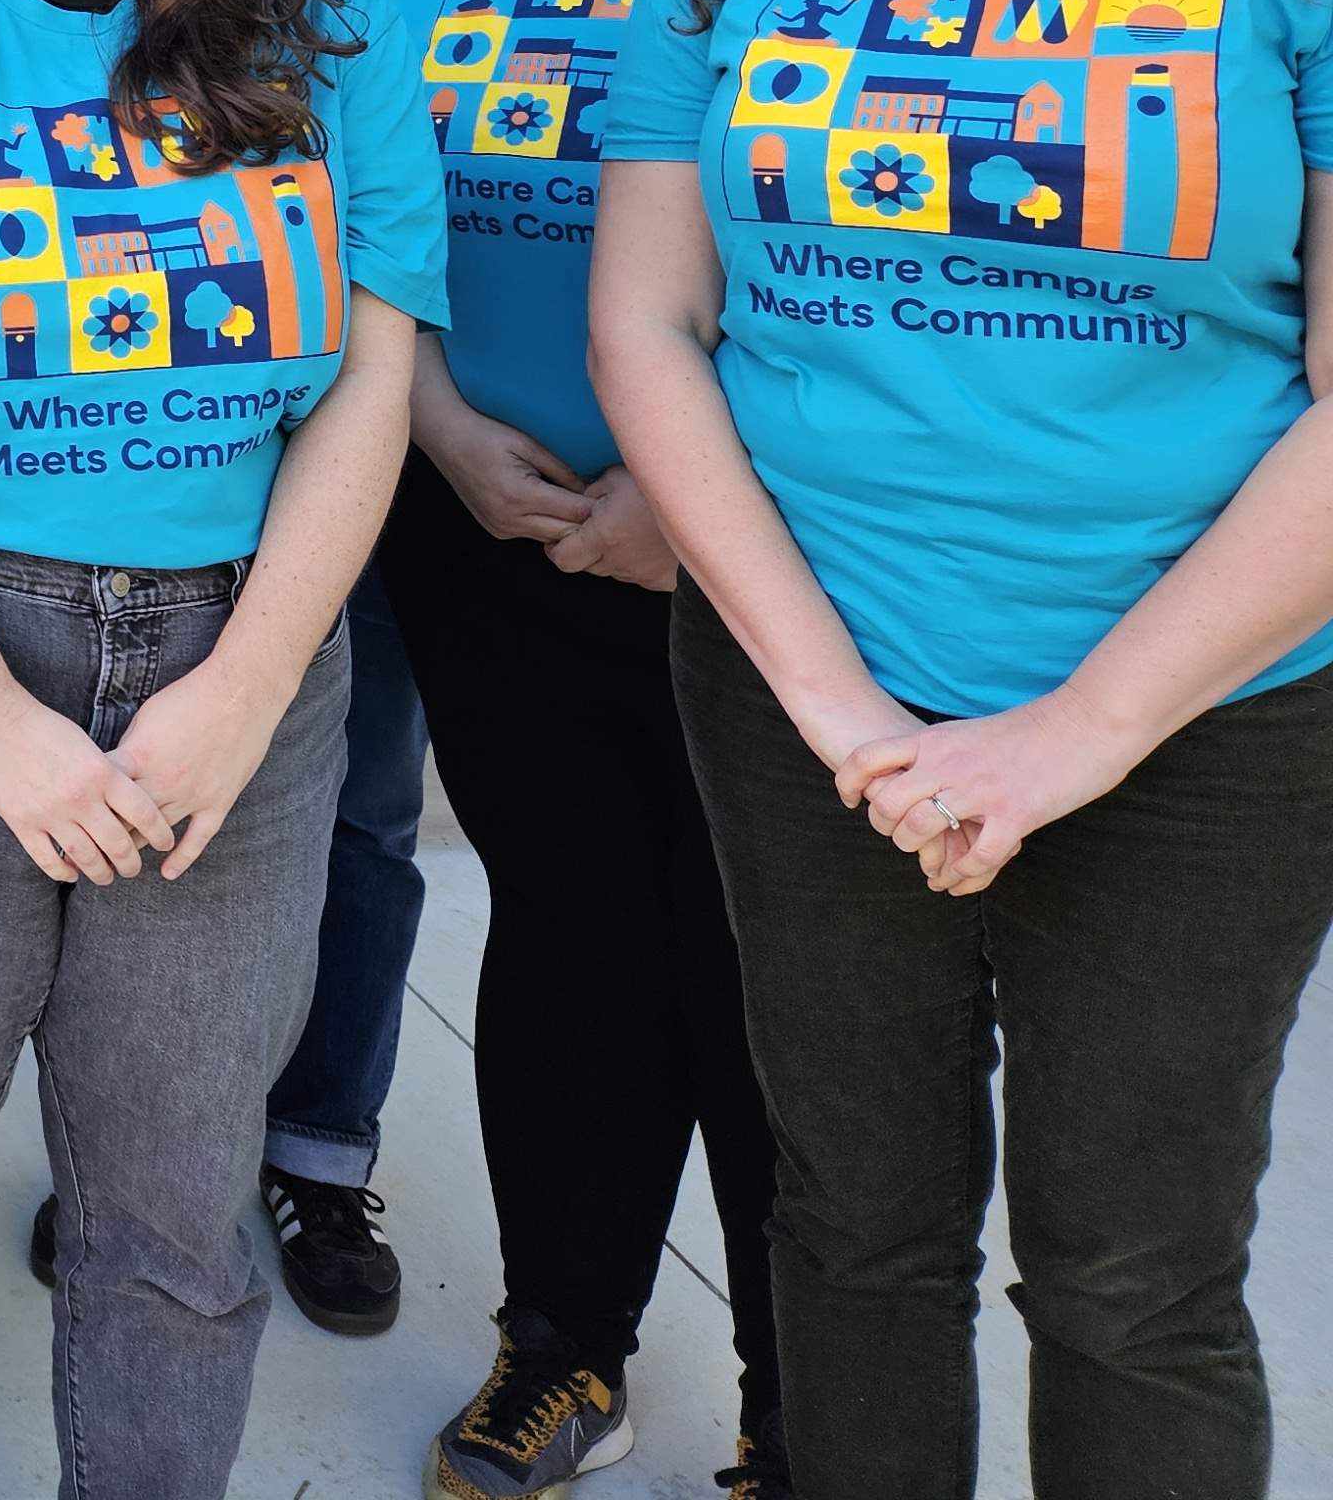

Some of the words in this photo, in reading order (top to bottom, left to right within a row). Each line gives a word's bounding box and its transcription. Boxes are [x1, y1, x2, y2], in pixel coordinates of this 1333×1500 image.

[445, 170, 533, 202] here
[447, 210, 502, 235] ets
[763, 241, 923, 284] Where
[940, 255, 1157, 305] Campus
[747, 283, 874, 328] Meets
[891, 297, 1188, 350] Community
[3, 397, 147, 430] Where
